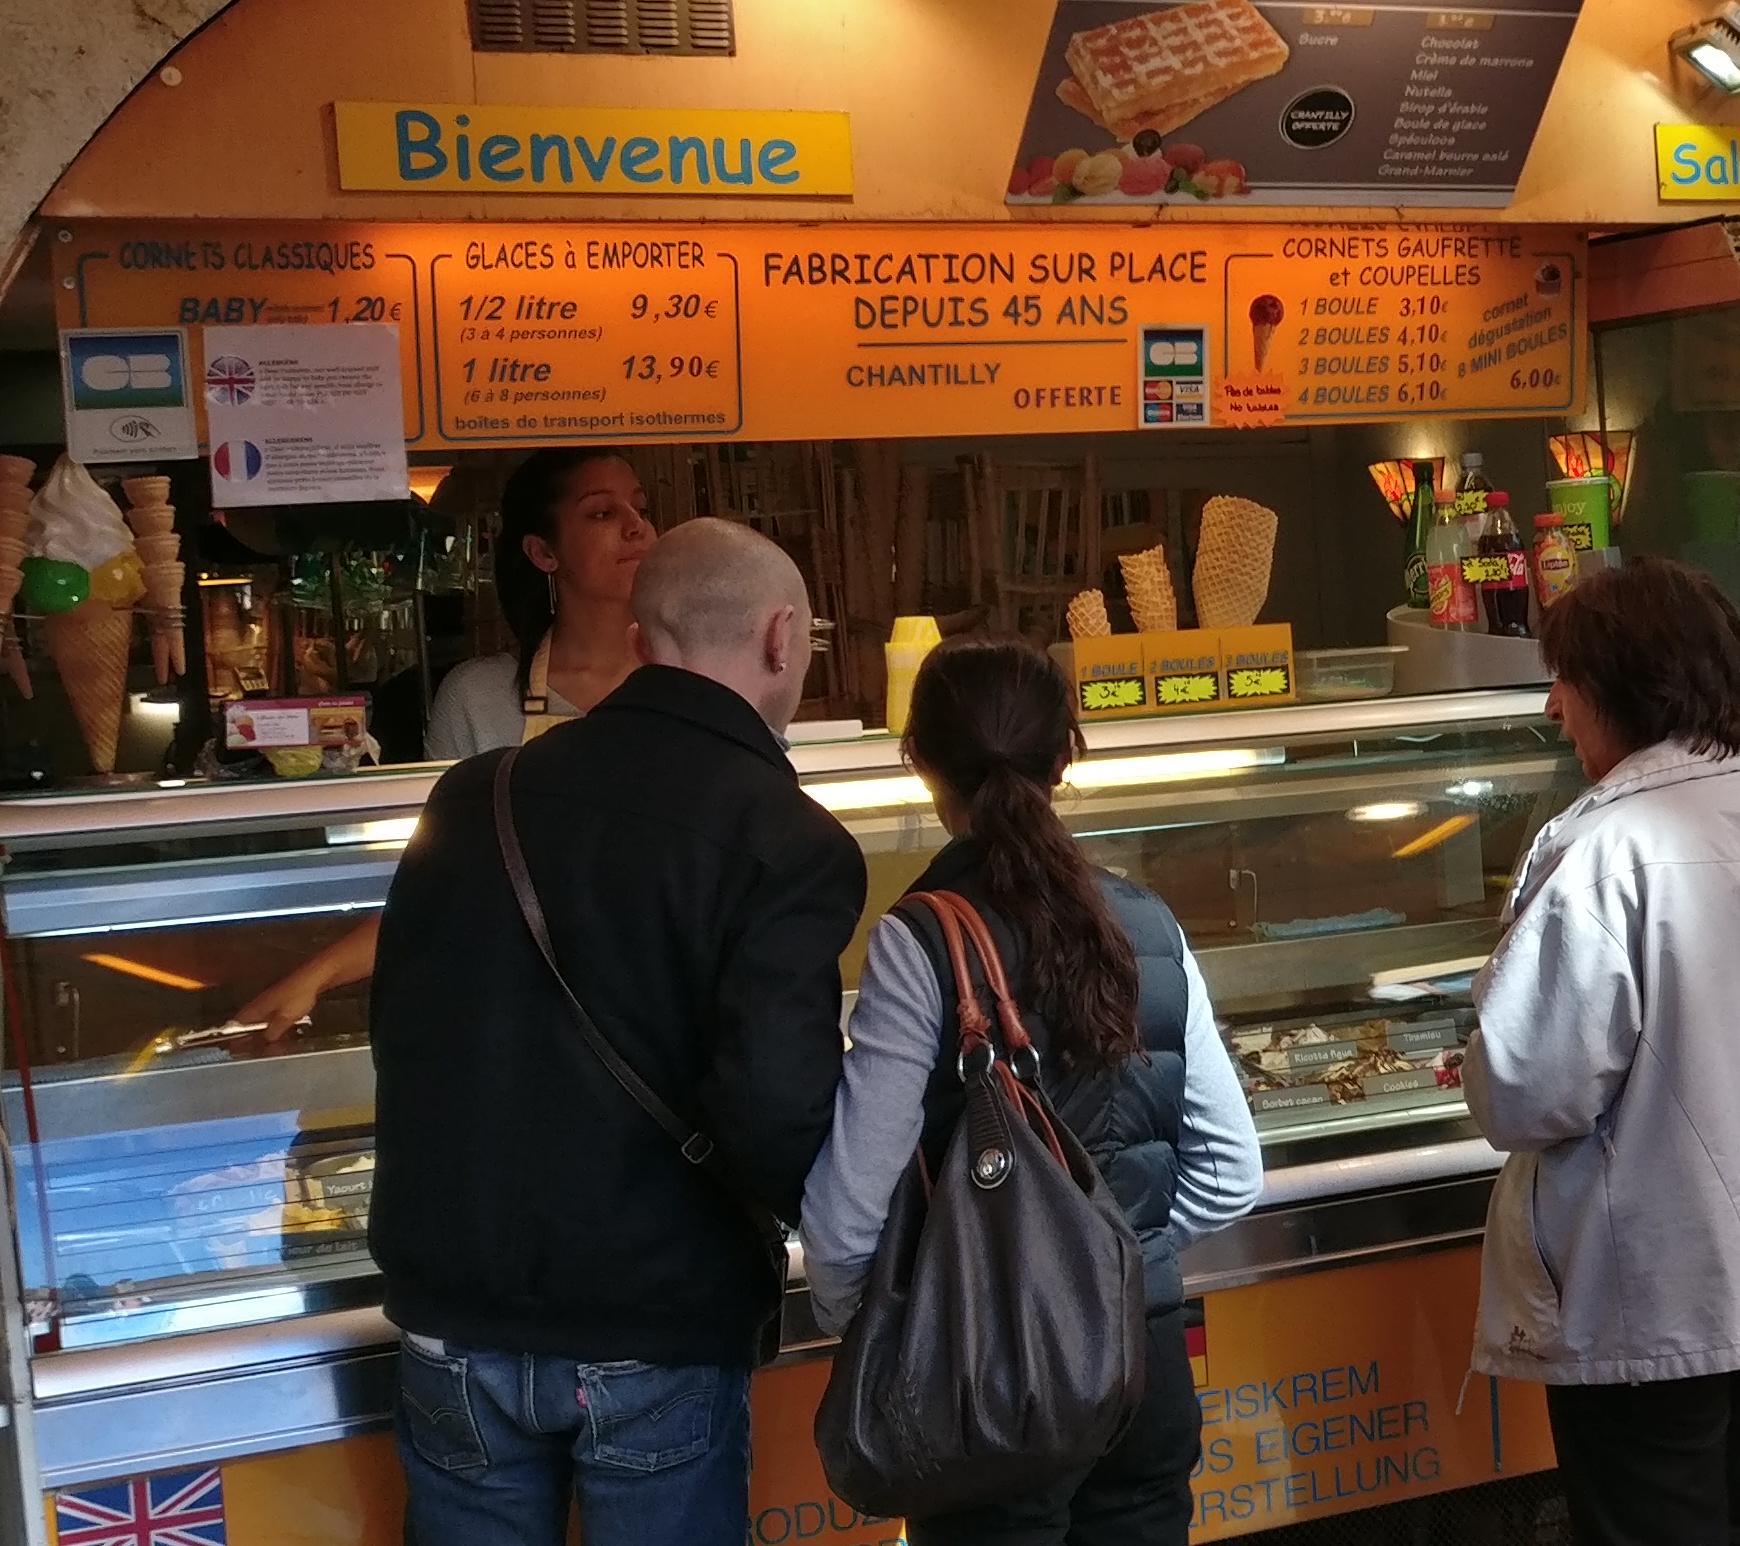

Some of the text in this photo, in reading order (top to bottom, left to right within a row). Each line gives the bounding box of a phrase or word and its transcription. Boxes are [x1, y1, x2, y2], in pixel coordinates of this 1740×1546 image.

[1421, 35, 1480, 50] Chocolat
[1410, 69, 1439, 82] Miel
[1404, 84, 1453, 99] Nutella
[393, 108, 802, 186] Bienvenue
[234, 241, 376, 275] CLASSIQUES
[465, 240, 706, 271] GLACES à EMPORTER
[1282, 235, 1523, 260] CORNETS GAUFRETTE
[763, 250, 1208, 287] FABRICATION SUR PLACE
[1328, 264, 1482, 288] et COUPELLES
[179, 297, 269, 324] BABY
[459, 295, 506, 321] 1/2
[515, 295, 578, 321] litre
[853, 294, 1129, 330] DEPUIS 45 ANS
[1300, 297, 1308, 317] 1
[1313, 296, 1380, 317] BOULE
[1482, 291, 1530, 324] cornet
[509, 325, 604, 343] personnes)
[1298, 326, 1310, 347] 2
[1313, 325, 1391, 347] BOULES
[1467, 305, 1553, 351] dégustation
[1505, 321, 1569, 362] BOULES
[463, 357, 477, 384] 1
[488, 356, 552, 384] litre
[845, 362, 1002, 388] CHANTILLY
[1298, 356, 1310, 376] 3
[1313, 355, 1391, 376] BOULES
[513, 386, 607, 404] personnes)
[1013, 385, 1122, 409] OFFERTE
[1298, 385, 1310, 404] 4
[1313, 384, 1391, 406] BOULES
[516, 413, 538, 429] de
[542, 412, 625, 431] transport
[629, 410, 726, 427] isothermes
[1382, 1078, 1419, 1093] Cookies
[1195, 1360, 1380, 1426] EISKREM
[1254, 1400, 1430, 1465] EIGENER
[1188, 1445, 1441, 1530] RSTELLUNG
